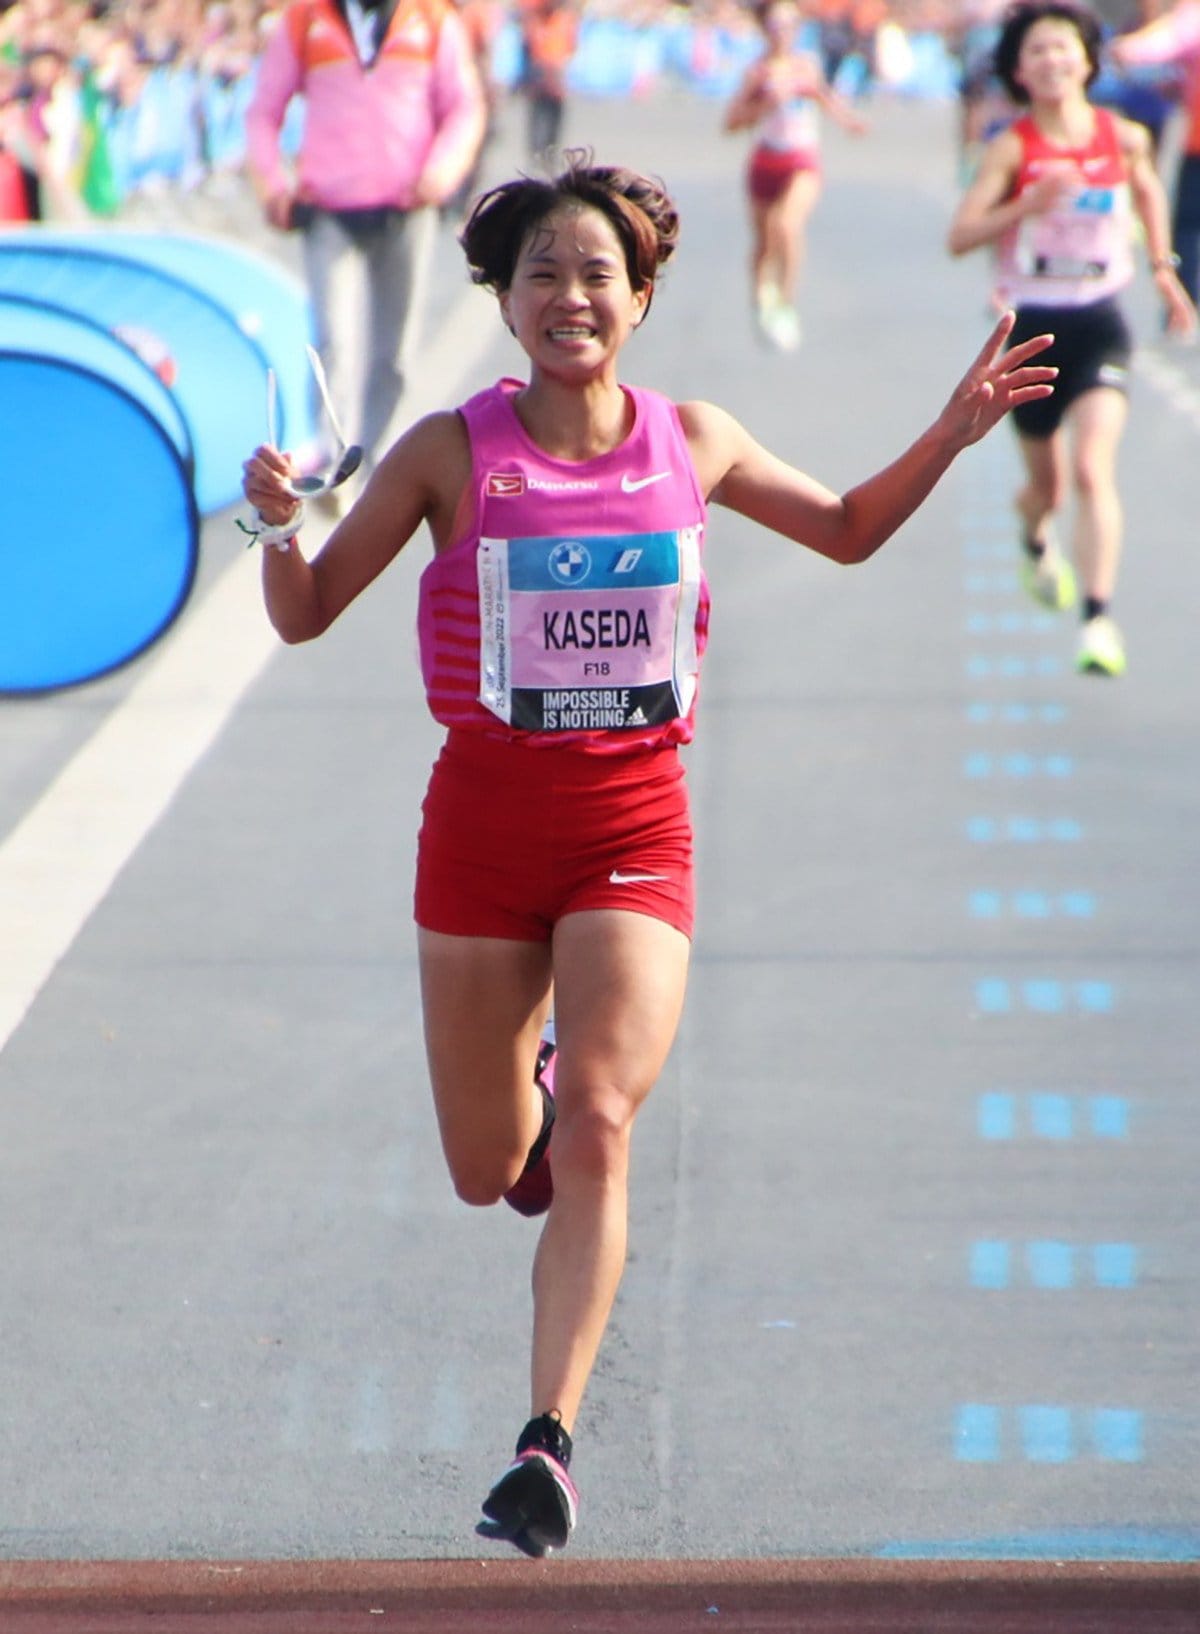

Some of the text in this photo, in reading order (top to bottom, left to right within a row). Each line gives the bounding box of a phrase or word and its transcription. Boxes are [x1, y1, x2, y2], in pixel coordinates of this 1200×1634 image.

[495, 617, 504, 641] 2022
[543, 609, 651, 650] KASEDA
[584, 662, 610, 676] F18
[543, 689, 630, 709] IMPOSSIBLE
[543, 710, 558, 729] IS
